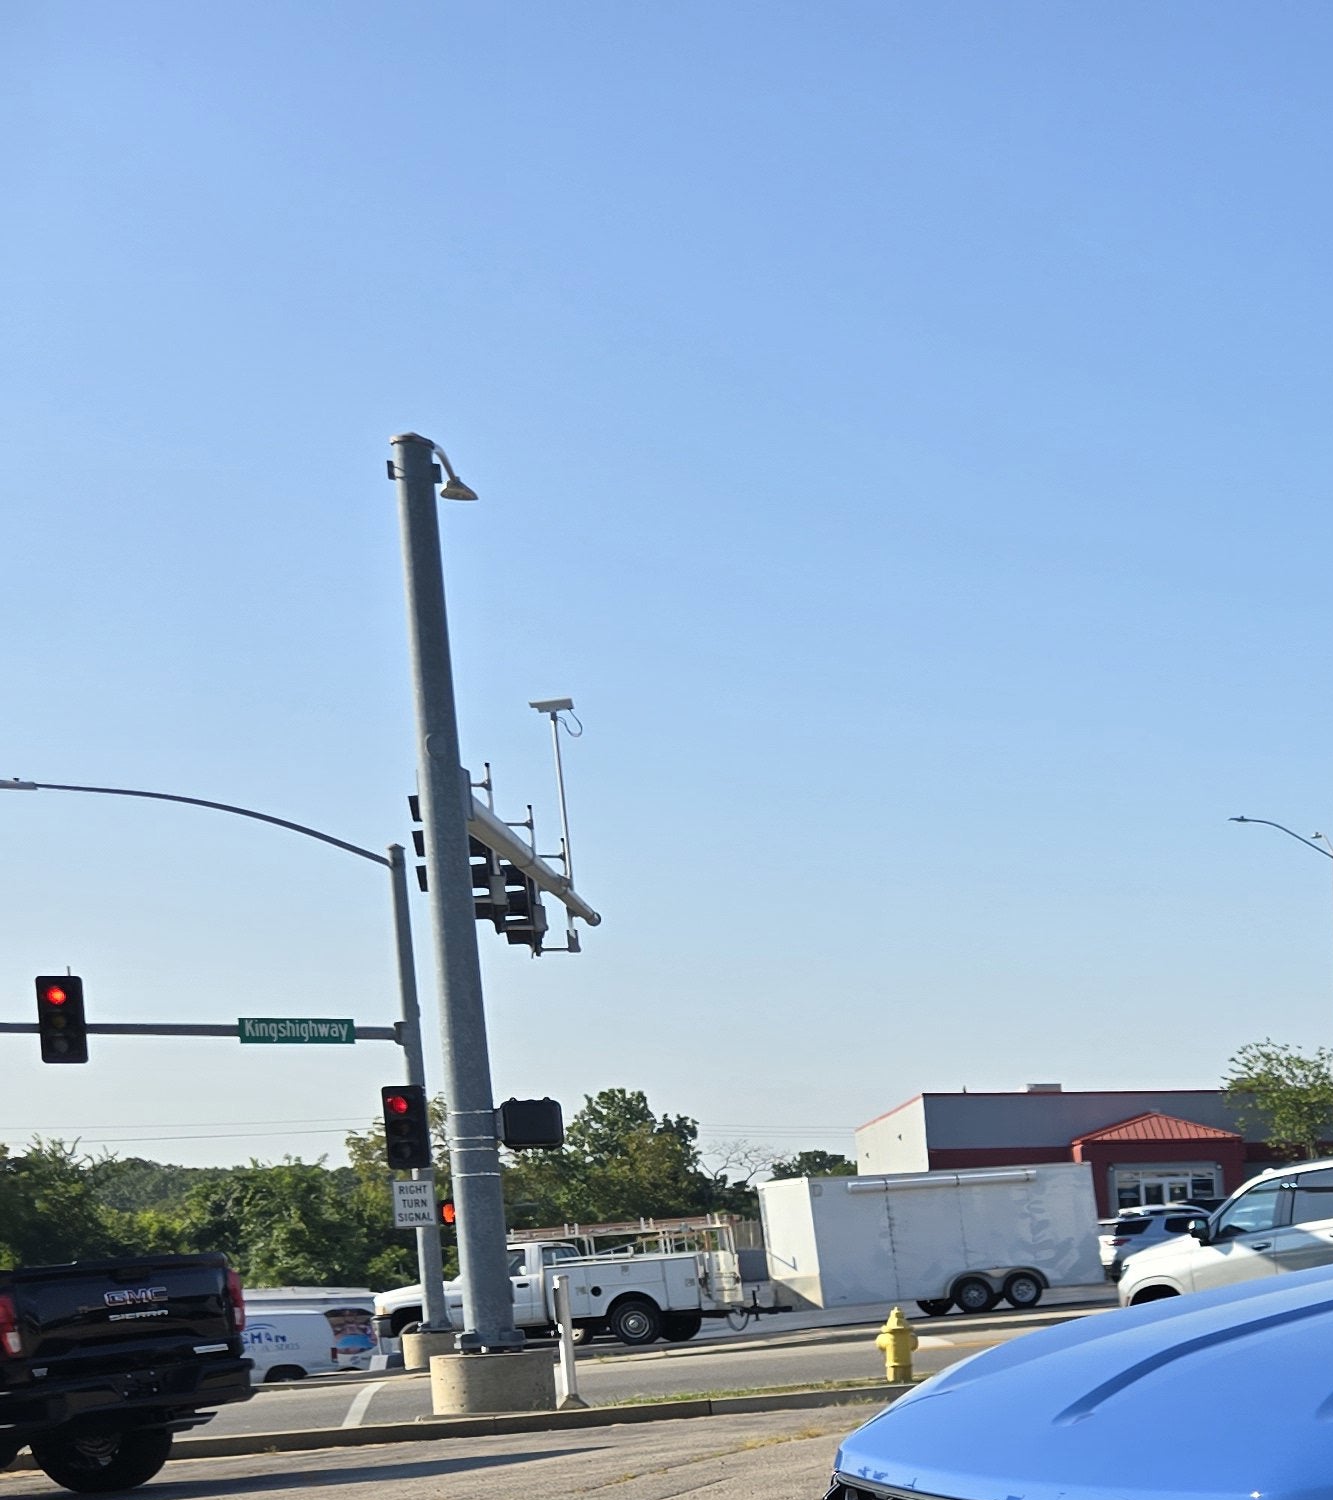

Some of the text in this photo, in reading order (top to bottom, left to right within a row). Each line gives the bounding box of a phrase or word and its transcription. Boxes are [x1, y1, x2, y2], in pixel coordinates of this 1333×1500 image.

[244, 1019, 348, 1042] Kingshighway
[398, 1185, 428, 1195] RIGHT
[401, 1199, 428, 1209] TURN
[398, 1211, 433, 1222] SIGNAL
[104, 1286, 168, 1307] GMC
[108, 1309, 169, 1321] SIERRA
